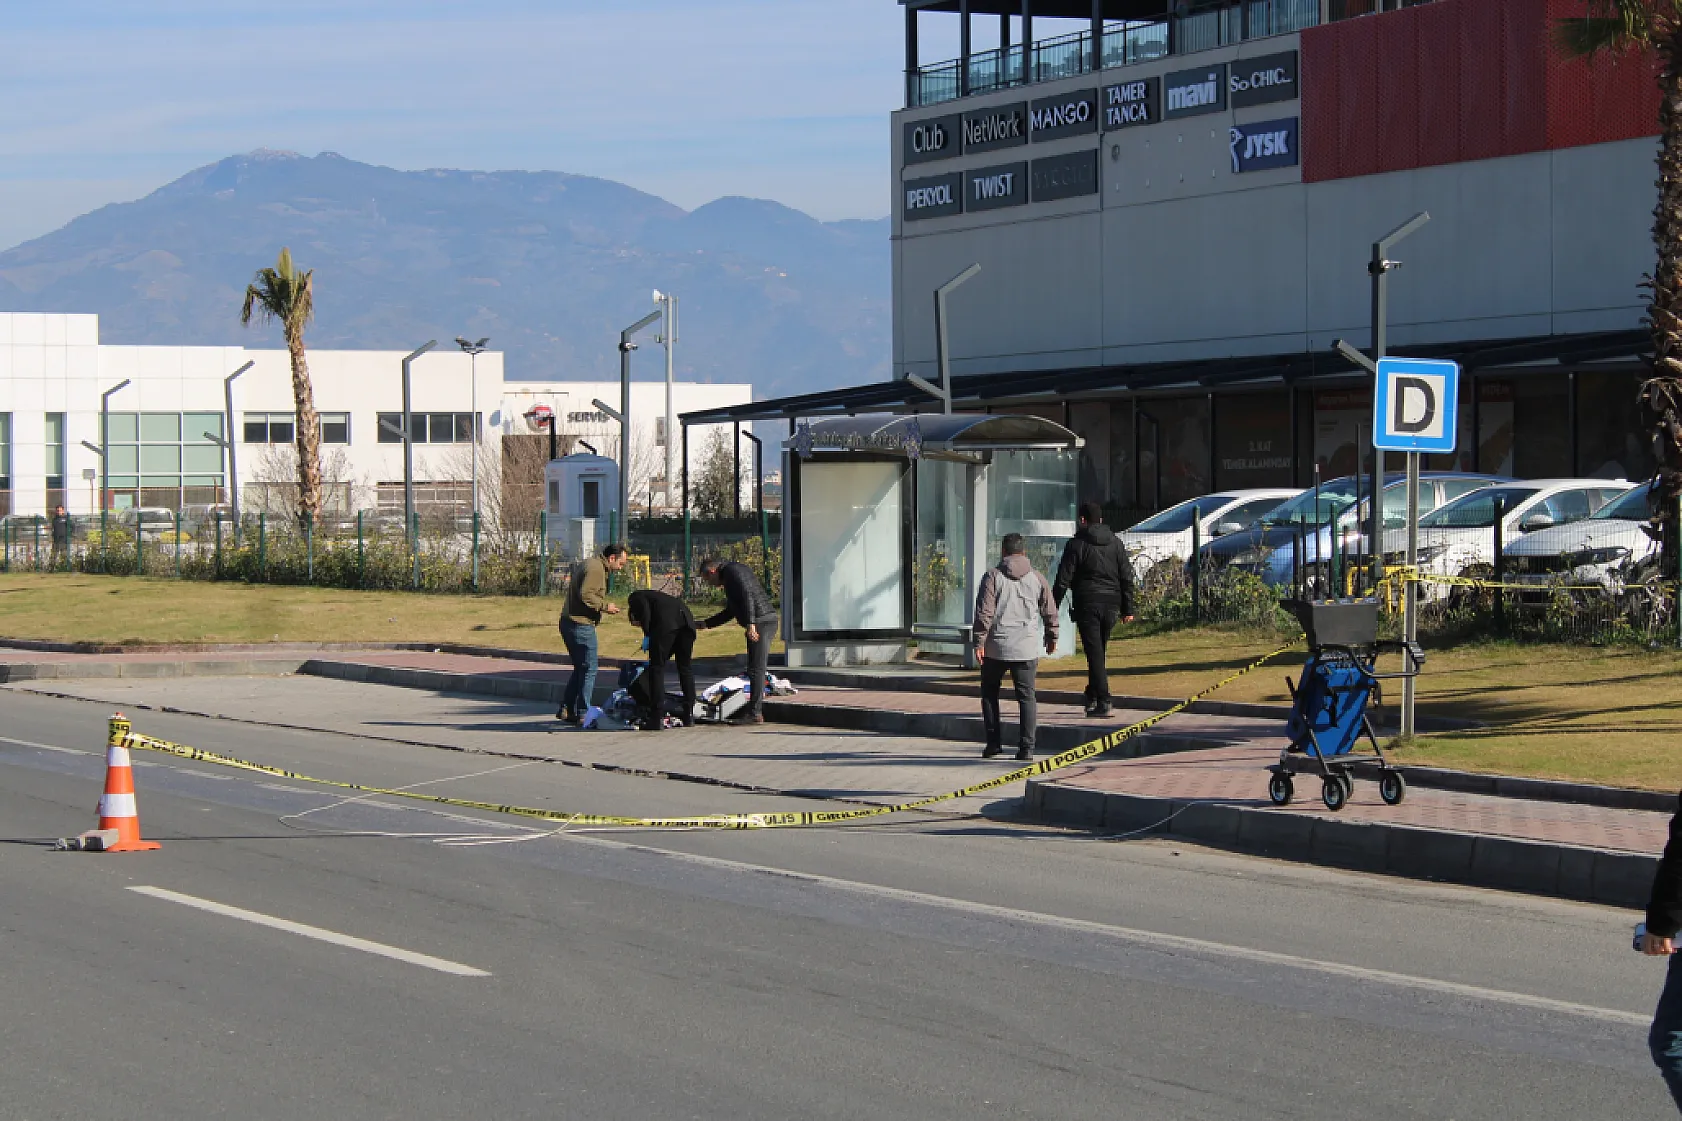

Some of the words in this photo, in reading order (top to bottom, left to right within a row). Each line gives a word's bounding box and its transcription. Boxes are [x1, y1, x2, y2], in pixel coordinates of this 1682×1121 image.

[1106, 81, 1147, 105] TAMER
[1168, 72, 1217, 111] mavi
[964, 112, 1021, 145] NetWork
[1031, 100, 1090, 131] MANGO
[1106, 102, 1148, 125] TANCA
[912, 123, 944, 153] Club
[1244, 130, 1289, 159] JYSK
[973, 172, 1013, 200] TWIST
[1394, 377, 1435, 433] D
